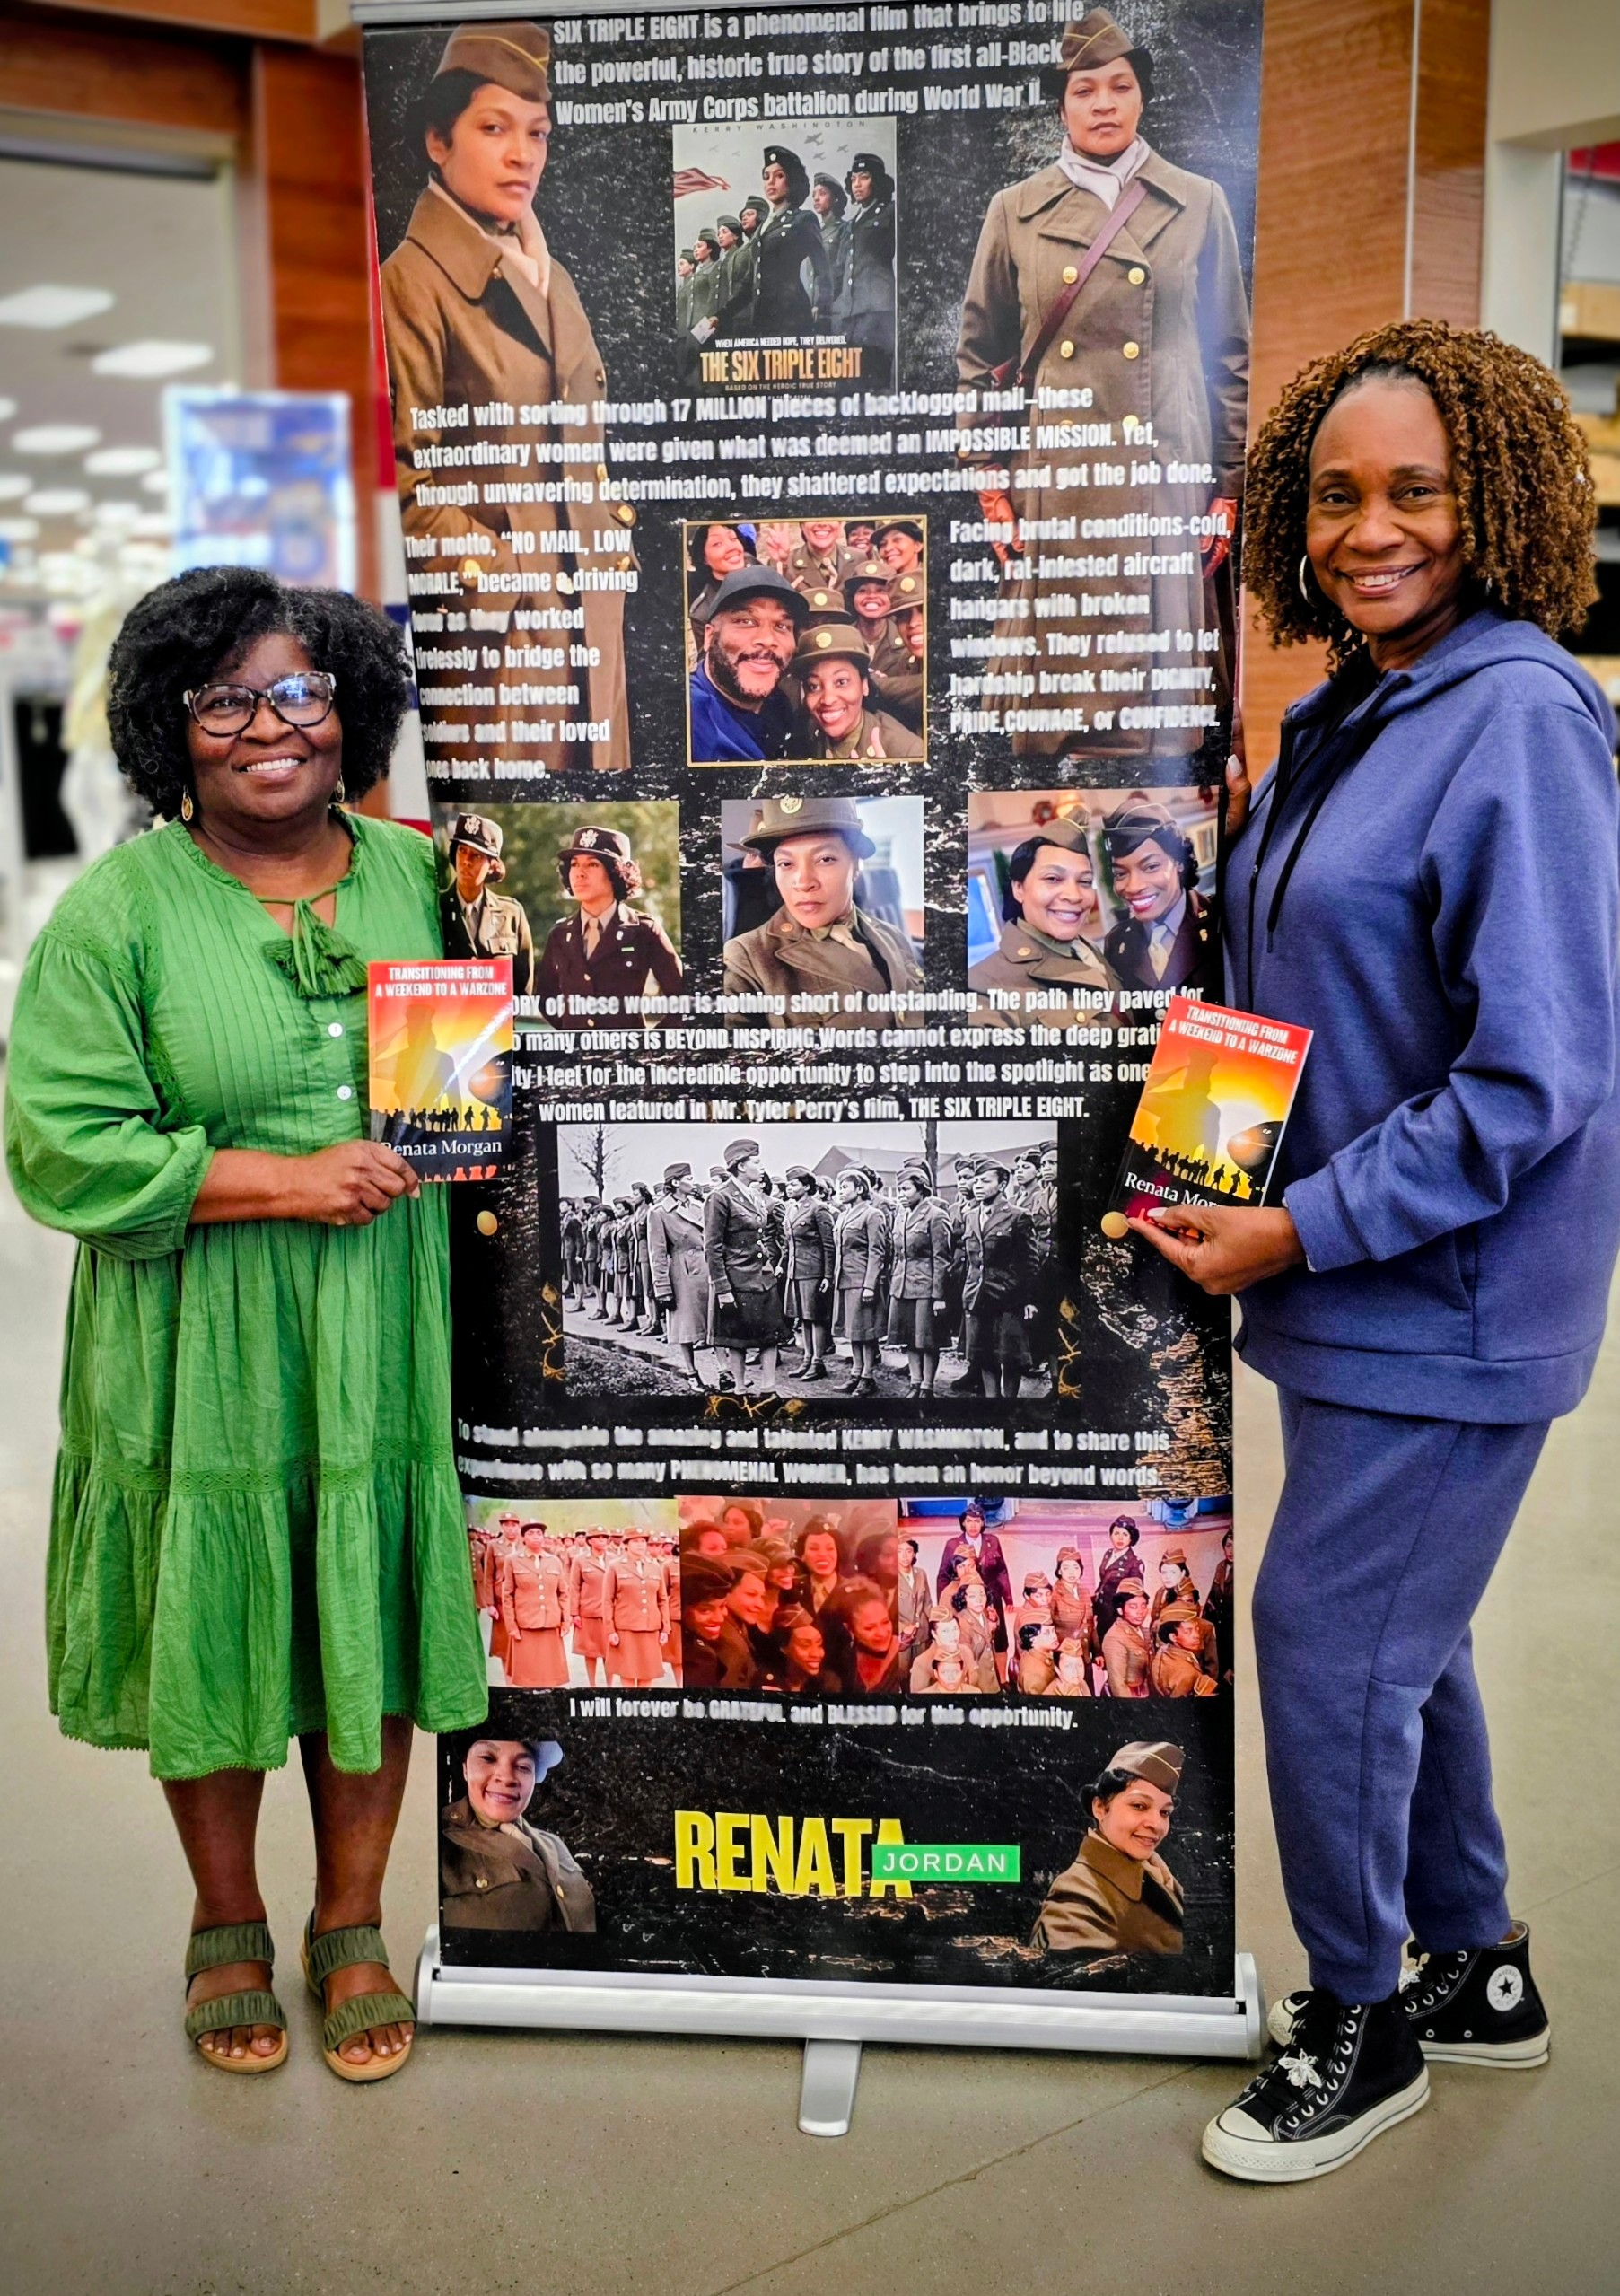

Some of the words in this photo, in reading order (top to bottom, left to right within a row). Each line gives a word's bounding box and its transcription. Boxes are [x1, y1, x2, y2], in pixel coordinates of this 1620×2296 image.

[553, 20, 582, 44] SIX
[587, 17, 644, 43] TRIPLE
[650, 15, 698, 39] EIGHT
[704, 13, 722, 38] is
[727, 17, 740, 37] a
[745, 7, 864, 39] phenomenal
[871, 5, 907, 31] film
[914, 4, 953, 29] that
[958, 1, 1021, 27] brings
[1027, 1, 1049, 22] to
[555, 61, 586, 84] the
[592, 56, 682, 86] powerful,
[687, 52, 763, 80] historic
[768, 52, 808, 75] true
[813, 49, 863, 76] story
[869, 47, 888, 72] of
[894, 47, 925, 71] the
[931, 43, 971, 69] first
[976, 39, 1063, 67] all-Black
[555, 99, 644, 125] Women's
[648, 97, 698, 123] Army
[703, 95, 759, 122] Corps
[764, 91, 849, 118] battalion
[856, 88, 918, 114] during
[924, 84, 980, 110] World
[985, 84, 1021, 108] War
[1029, 82, 1046, 106] II.
[692, 124, 741, 134] KERRY
[700, 352, 729, 382] THE
[731, 350, 759, 381] SIX
[763, 348, 814, 380] TRIPLE
[818, 347, 862, 379] EIGHT
[411, 404, 468, 430] Tasked
[473, 402, 514, 426] with
[671, 399, 691, 422] 17
[696, 396, 766, 422] MILLION
[772, 394, 836, 422] pieces
[841, 393, 860, 416] of
[864, 389, 976, 416] backlogged
[414, 441, 530, 469] extraordinary
[537, 442, 605, 463] women
[610, 440, 657, 462] were
[662, 437, 714, 463] given
[719, 434, 766, 460] what
[772, 436, 810, 458] was
[815, 431, 891, 455] deemed
[897, 433, 921, 453] an
[926, 426, 1030, 453] IMPOSSIBLE
[1037, 423, 1116, 449] MISSION.
[1123, 422, 1159, 449] Yet,
[416, 480, 479, 507] through
[484, 478, 593, 504] unwavering
[599, 475, 736, 501] determination,
[741, 474, 783, 500] they
[788, 470, 880, 495] shattered
[885, 467, 1009, 495] expectations
[1015, 465, 1051, 488] and
[1055, 463, 1088, 490] got
[1093, 461, 1125, 486] the
[1130, 460, 1160, 486] job
[1166, 460, 1217, 484] done.
[540, 530, 589, 555] MAIL,
[594, 530, 632, 553] LOW
[477, 570, 551, 592] became
[573, 567, 638, 592] driving
[514, 607, 584, 629] worked
[482, 646, 500, 668] to
[504, 644, 564, 669] bridge
[570, 644, 600, 667] the
[560, 720, 609, 741] loved
[388, 966, 464, 981] TRANSITIONING
[467, 966, 494, 980] FROM
[375, 984, 382, 997] A
[386, 984, 433, 996] WEEKEND
[434, 984, 448, 996] TO
[451, 983, 458, 996] A
[460, 982, 507, 996] WARZONE
[568, 995, 619, 1014] these
[625, 995, 689, 1014] women
[717, 991, 785, 1015] nothing
[791, 991, 838, 1012] short
[844, 991, 862, 1012] of
[867, 989, 982, 1012] outstanding.
[989, 988, 1020, 1009] The
[1025, 989, 1068, 1012] path
[1073, 987, 1115, 1012] they
[526, 1032, 574, 1054] many
[580, 1030, 638, 1050] others
[644, 1030, 661, 1049] is
[666, 1030, 729, 1050] BEYOND
[881, 1026, 946, 1047] cannot
[950, 1027, 1025, 1048] express
[1030, 1025, 1061, 1045] the
[1066, 1024, 1113, 1048] deep
[1187, 1005, 1260, 1039] TRANSITIONING
[1257, 1025, 1290, 1045] FROM
[1168, 1019, 1177, 1032] A
[1178, 1021, 1223, 1047] WEEKEND
[1222, 1031, 1237, 1048] TO
[1237, 1036, 1246, 1050] A
[1248, 1038, 1299, 1065] WARZONE
[586, 1065, 610, 1084] for
[617, 1065, 645, 1084] the
[651, 1063, 741, 1084] incredible
[747, 1063, 851, 1088] opportunity
[856, 1065, 874, 1084] to
[880, 1061, 920, 1086] step
[925, 1061, 960, 1082] into
[966, 1061, 996, 1082] the
[1002, 1058, 1085, 1084] spotlight
[1090, 1063, 1113, 1082] as
[539, 1102, 605, 1122] women
[610, 1100, 685, 1120] featured
[689, 1099, 707, 1119] in
[713, 1100, 741, 1119] Mr.
[746, 1099, 789, 1122] Tyler
[796, 1099, 859, 1122] Perry's
[863, 1098, 905, 1121] film,
[910, 1098, 939, 1118] THE
[944, 1097, 971, 1118] SIX
[976, 1097, 1032, 1117] TRIPLE
[1038, 1097, 1090, 1117] EIGHT.
[442, 1140, 503, 1156] Morgan
[1124, 1172, 1178, 1203] Renata
[1077, 1431, 1130, 1451] share
[1134, 1430, 1169, 1451] this
[1029, 1463, 1095, 1486] beyond
[1100, 1465, 1163, 1485] words.
[570, 1698, 575, 1716] I
[580, 1697, 611, 1717] will
[616, 1698, 679, 1718] forever
[790, 1704, 823, 1724] and
[674, 1810, 913, 1898] RENATA
[883, 1853, 1007, 1872] JORDAN
